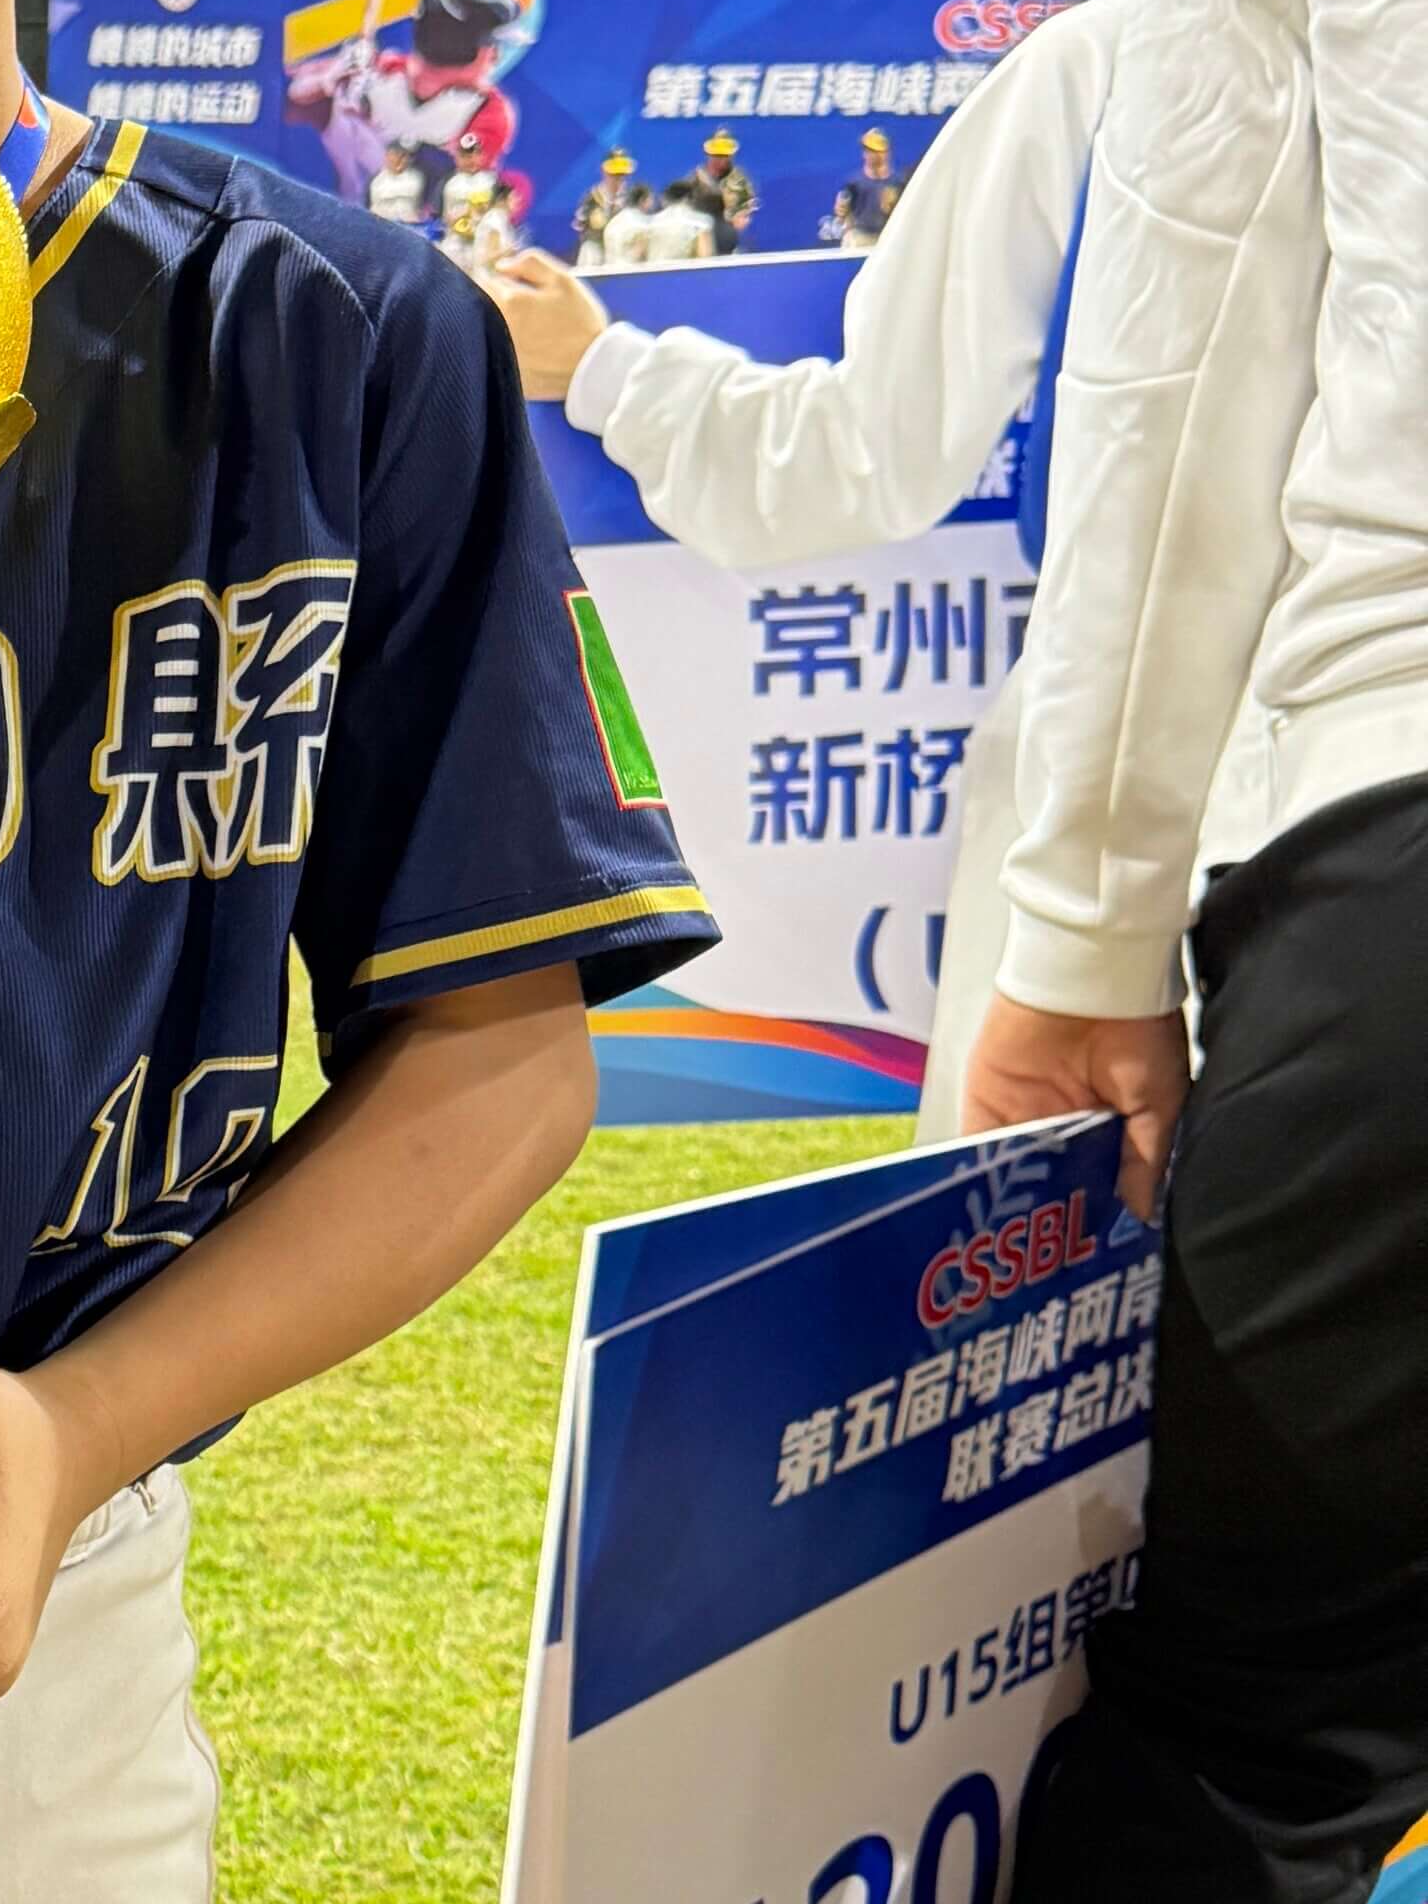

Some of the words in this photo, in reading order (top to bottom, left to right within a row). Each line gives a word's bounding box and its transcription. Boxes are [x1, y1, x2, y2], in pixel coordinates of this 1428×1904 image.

[917, 1189, 1097, 1330] CSSBL
[770, 1253, 1164, 1506] 第五届海峡两岸
